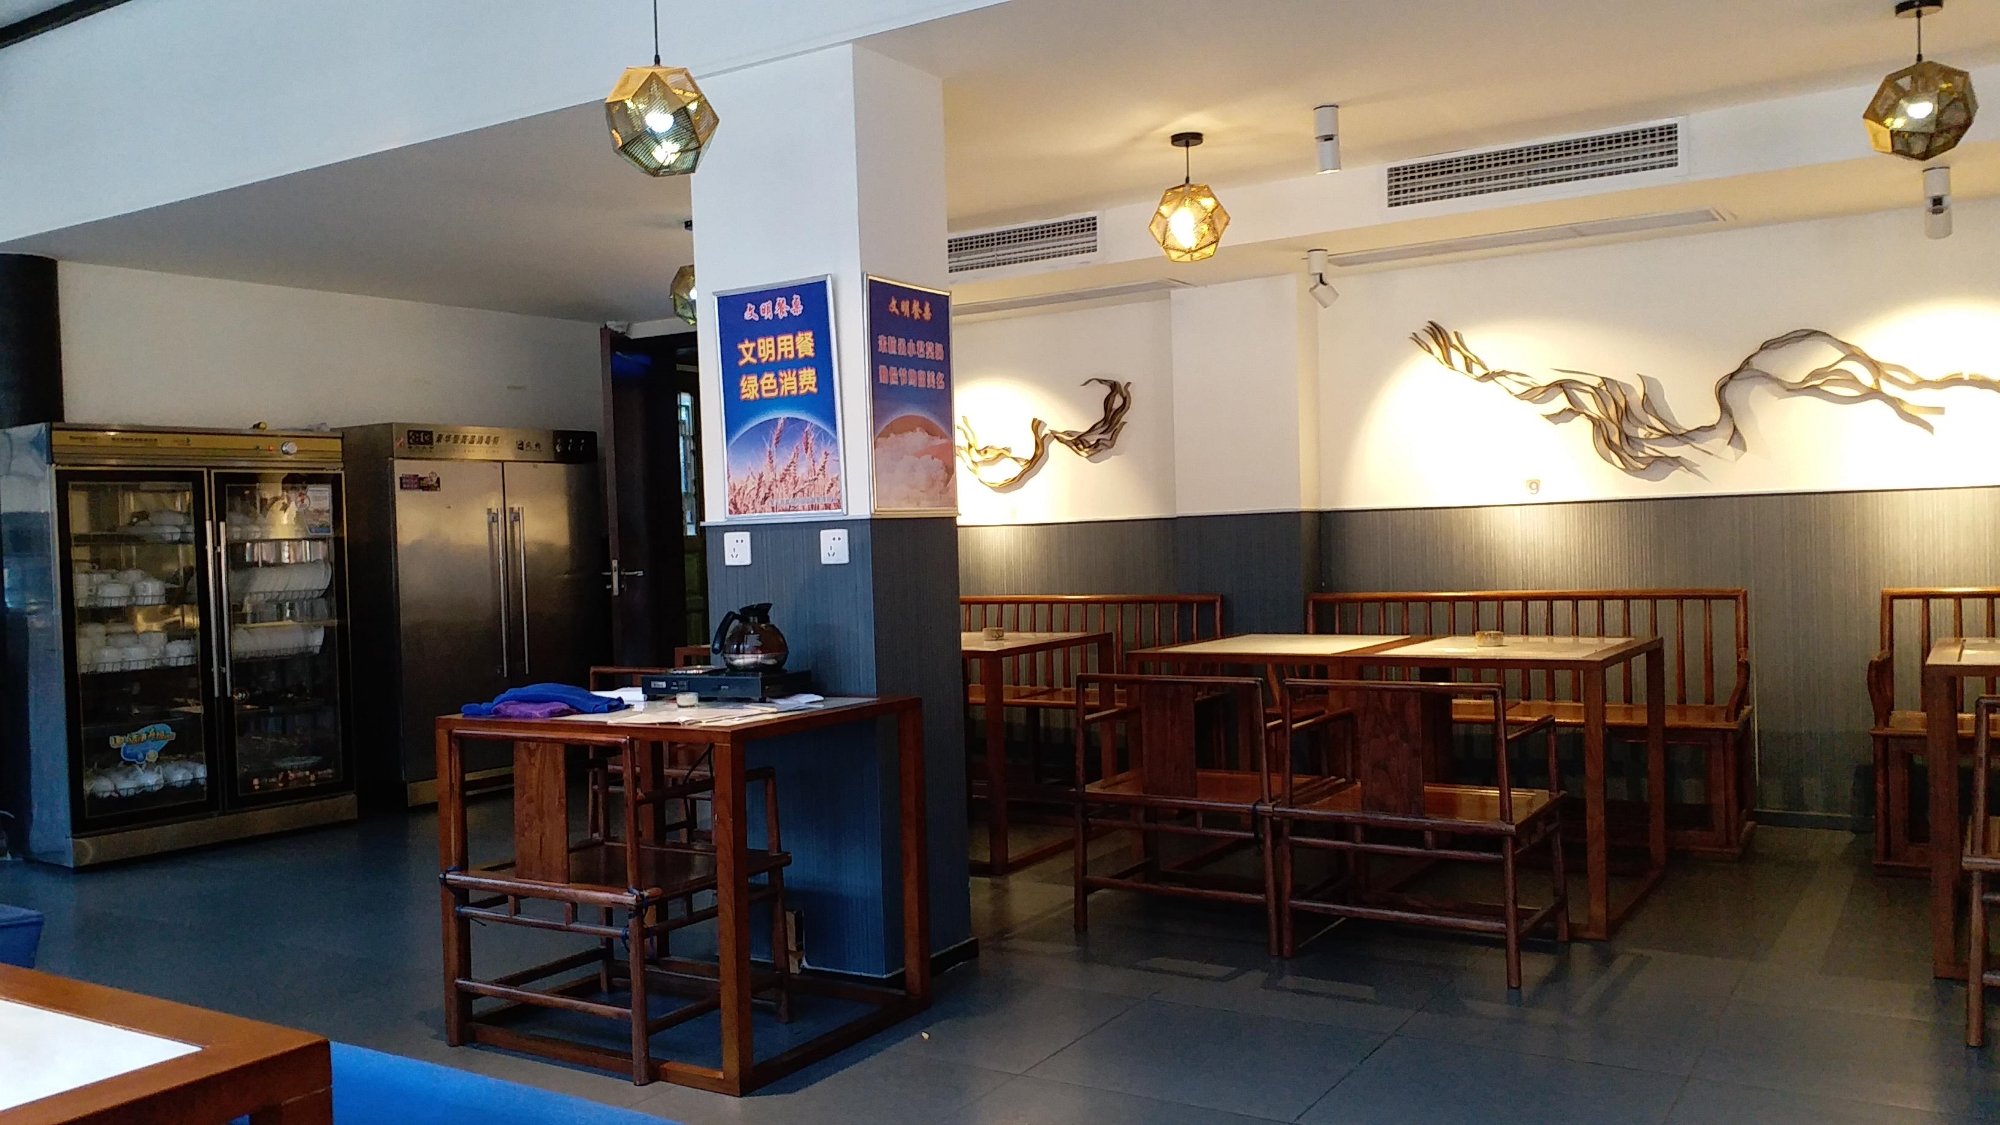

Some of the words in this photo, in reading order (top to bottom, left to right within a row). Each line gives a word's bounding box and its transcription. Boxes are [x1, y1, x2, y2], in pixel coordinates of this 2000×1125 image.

[744, 294, 804, 321] 文明餐桌
[888, 297, 932, 321] 文明餐桌
[737, 331, 815, 367] 文明用餐
[740, 367, 817, 401] 绿色消费
[1529, 481, 1540, 495] 9
